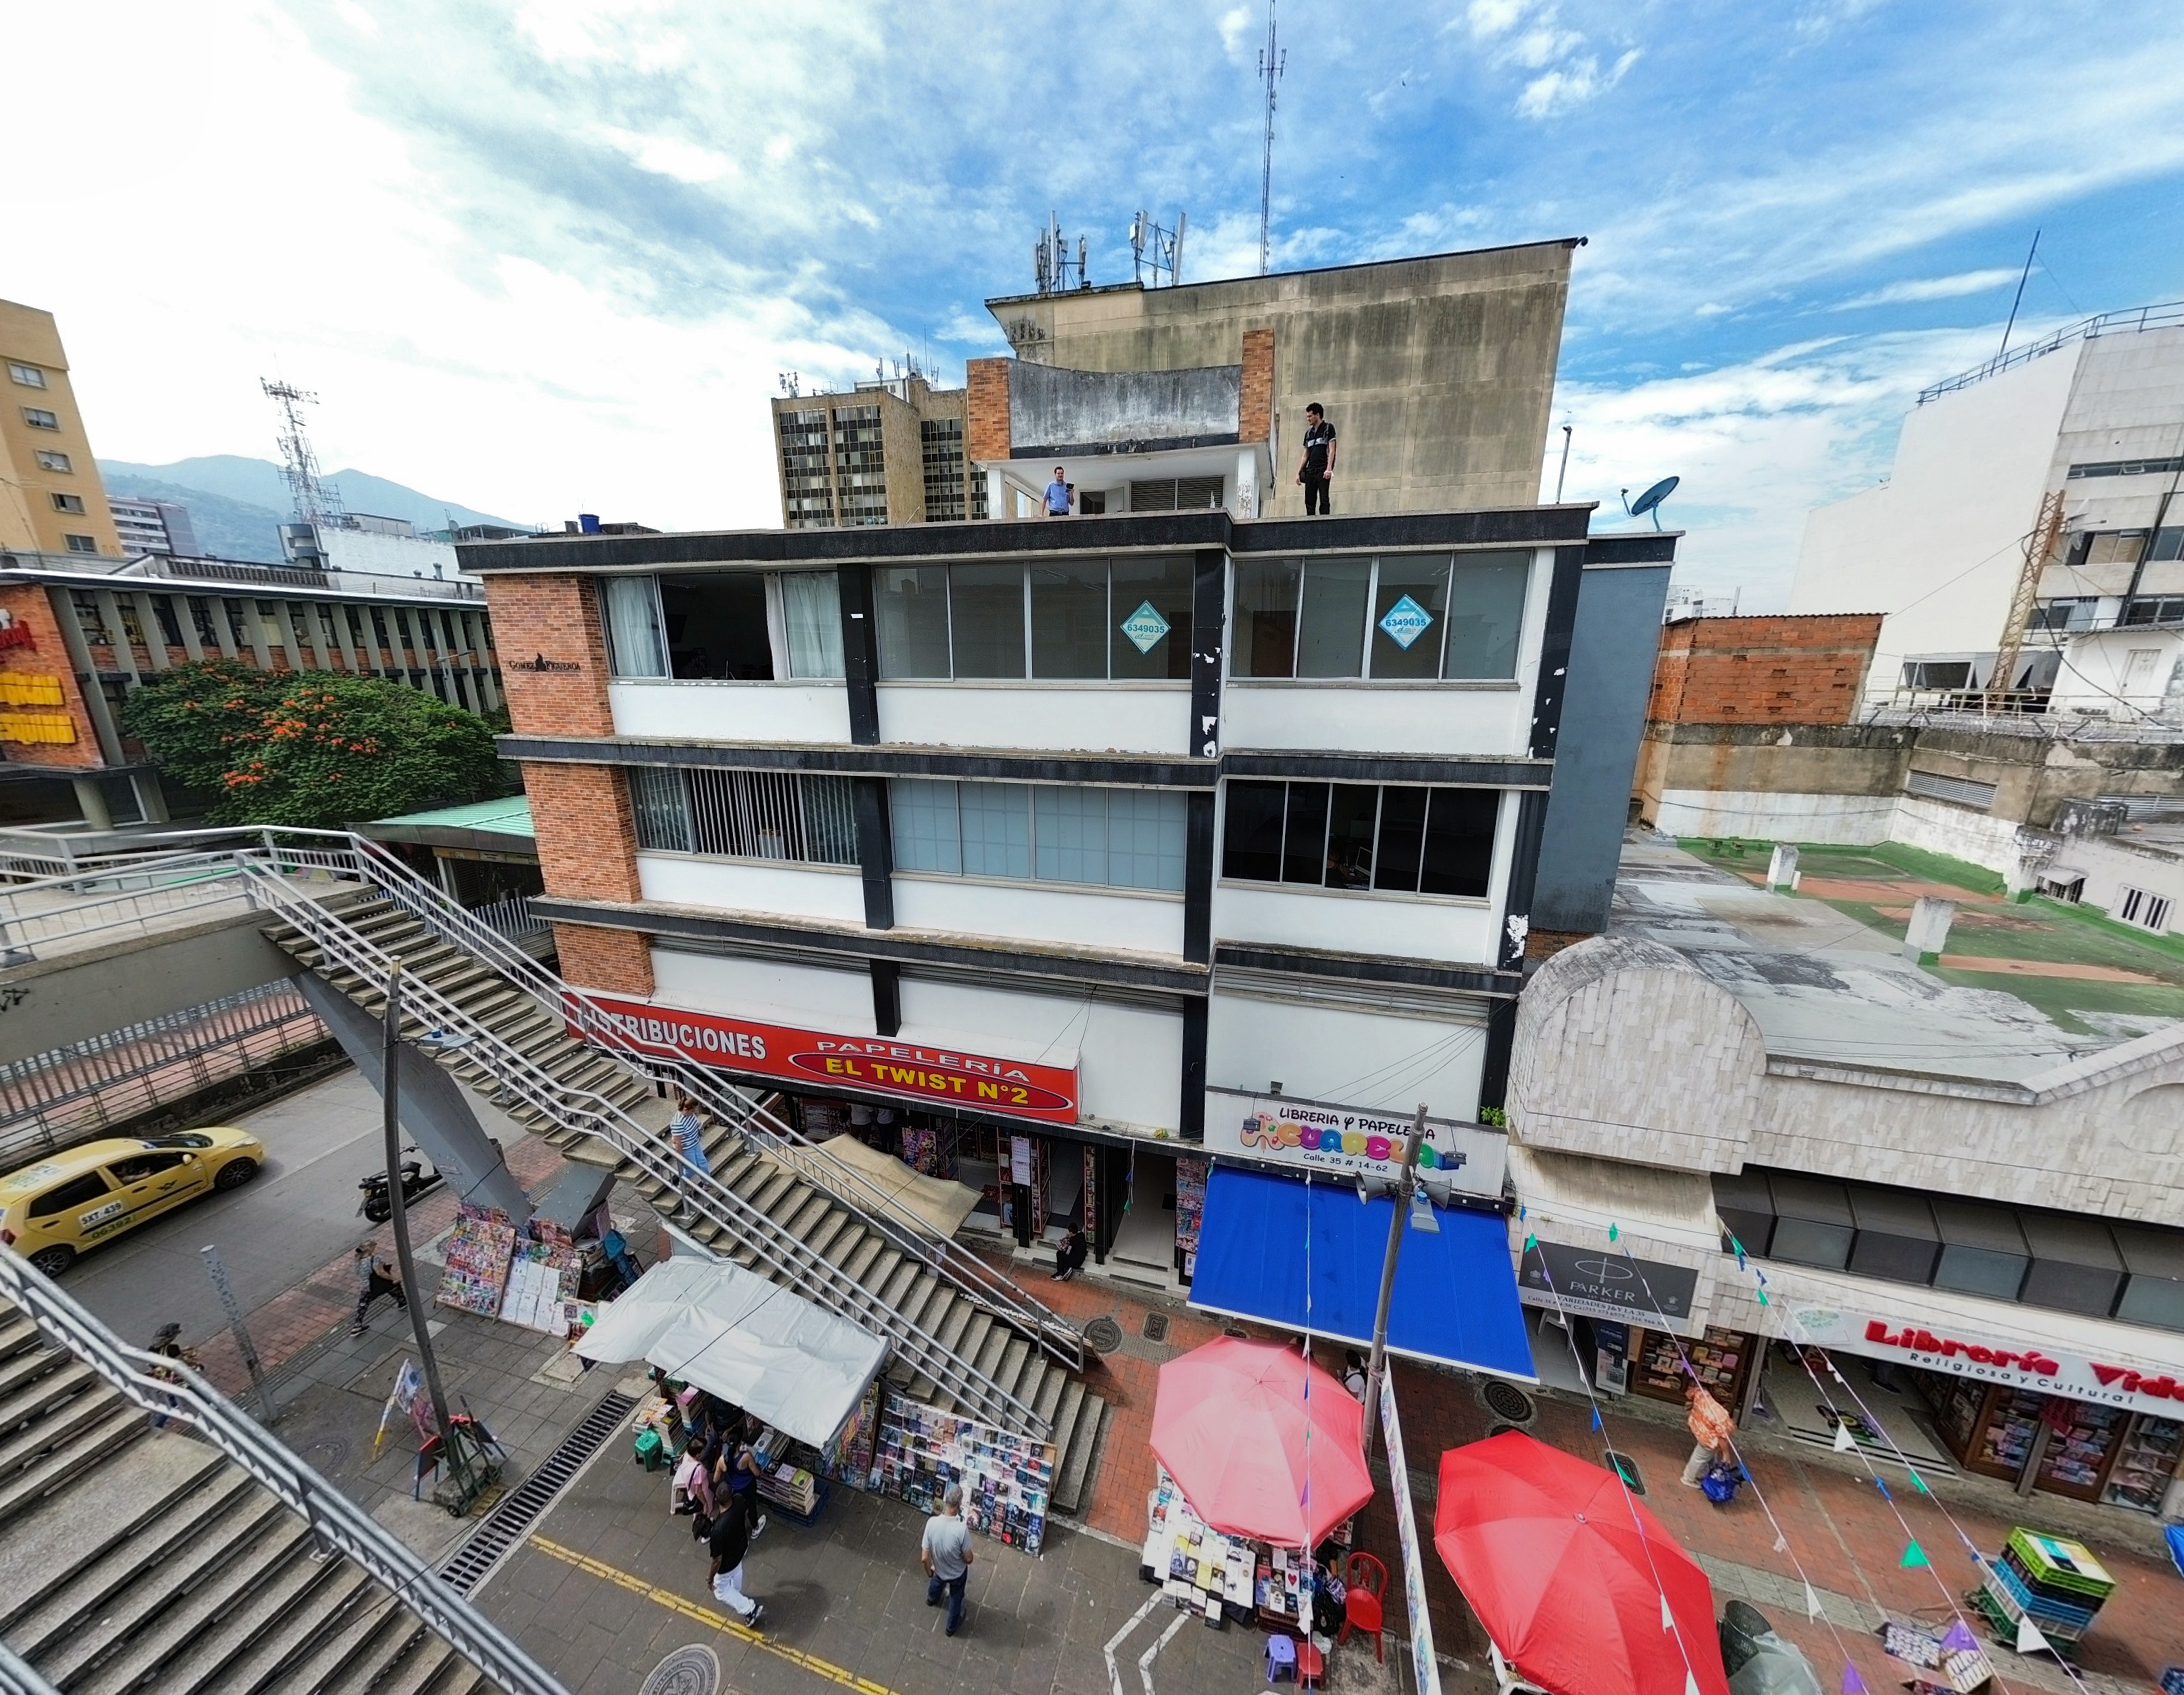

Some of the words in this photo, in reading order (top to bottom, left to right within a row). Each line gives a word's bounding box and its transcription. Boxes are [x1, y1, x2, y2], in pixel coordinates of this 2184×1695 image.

[1127, 624, 1165, 633] 6349035
[1385, 618, 1426, 627] 6349035
[817, 1041, 1031, 1083] PAPELERÍA
[826, 1057, 862, 1076] EL
[870, 1063, 966, 1093] TWIST
[1279, 1107, 1339, 1126] LIBRERIA
[1358, 1118, 1435, 1140] PAPELEA
[1303, 1153, 1325, 1162] Calle
[1359, 1161, 1388, 1172] 14-62
[1570, 1281, 1635, 1302] PARKER
[1864, 1319, 2060, 1377] Librería
[1909, 1352, 2011, 1379] Religiosa
[2037, 1378, 2134, 1404] Cultural
